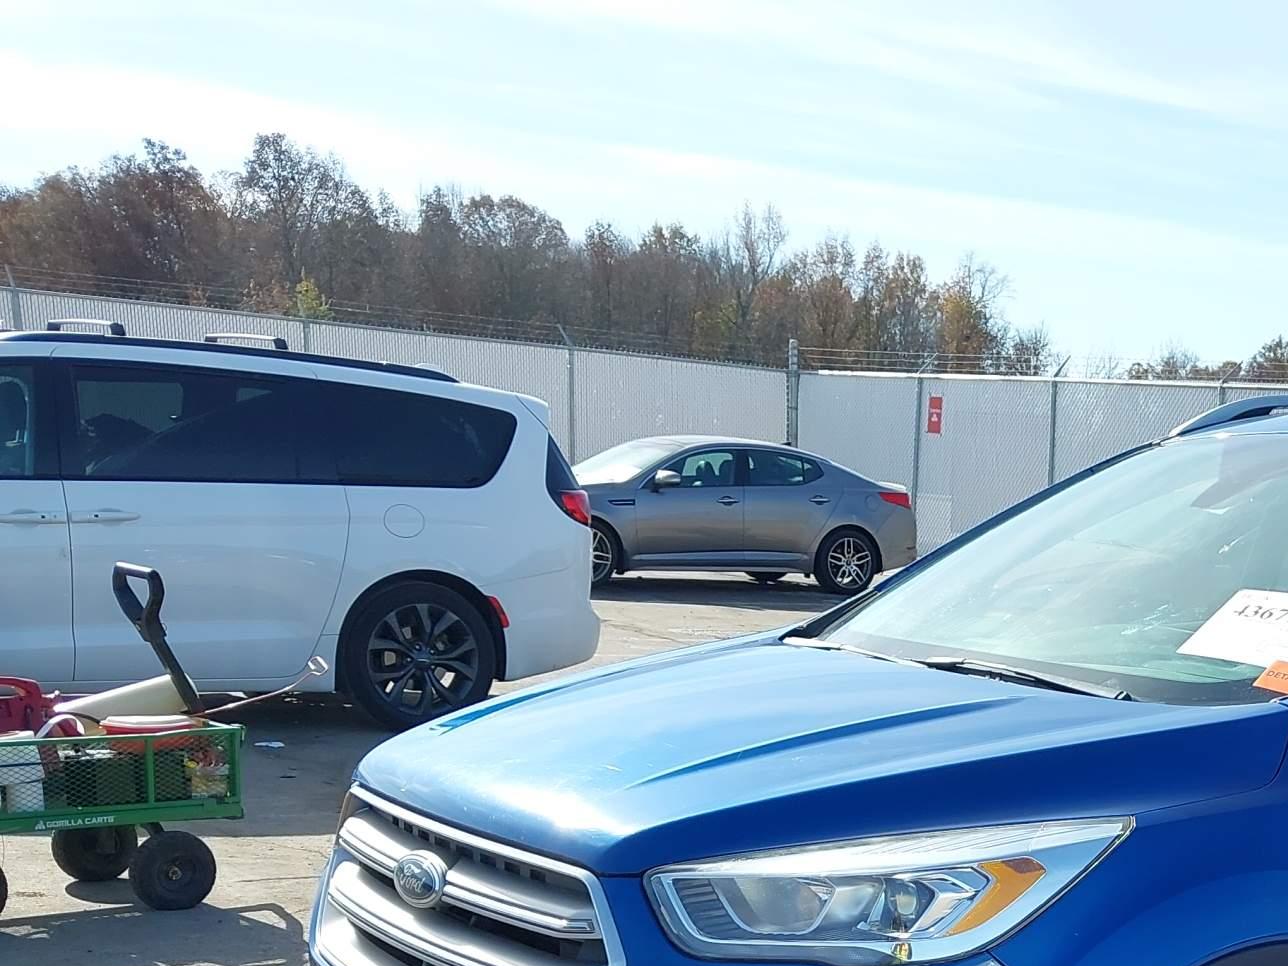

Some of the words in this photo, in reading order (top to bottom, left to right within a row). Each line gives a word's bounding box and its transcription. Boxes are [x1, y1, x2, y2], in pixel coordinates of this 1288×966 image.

[46, 819, 83, 829] GORILLA
[84, 816, 115, 825] CARTS
[400, 863, 427, 894] Ford
